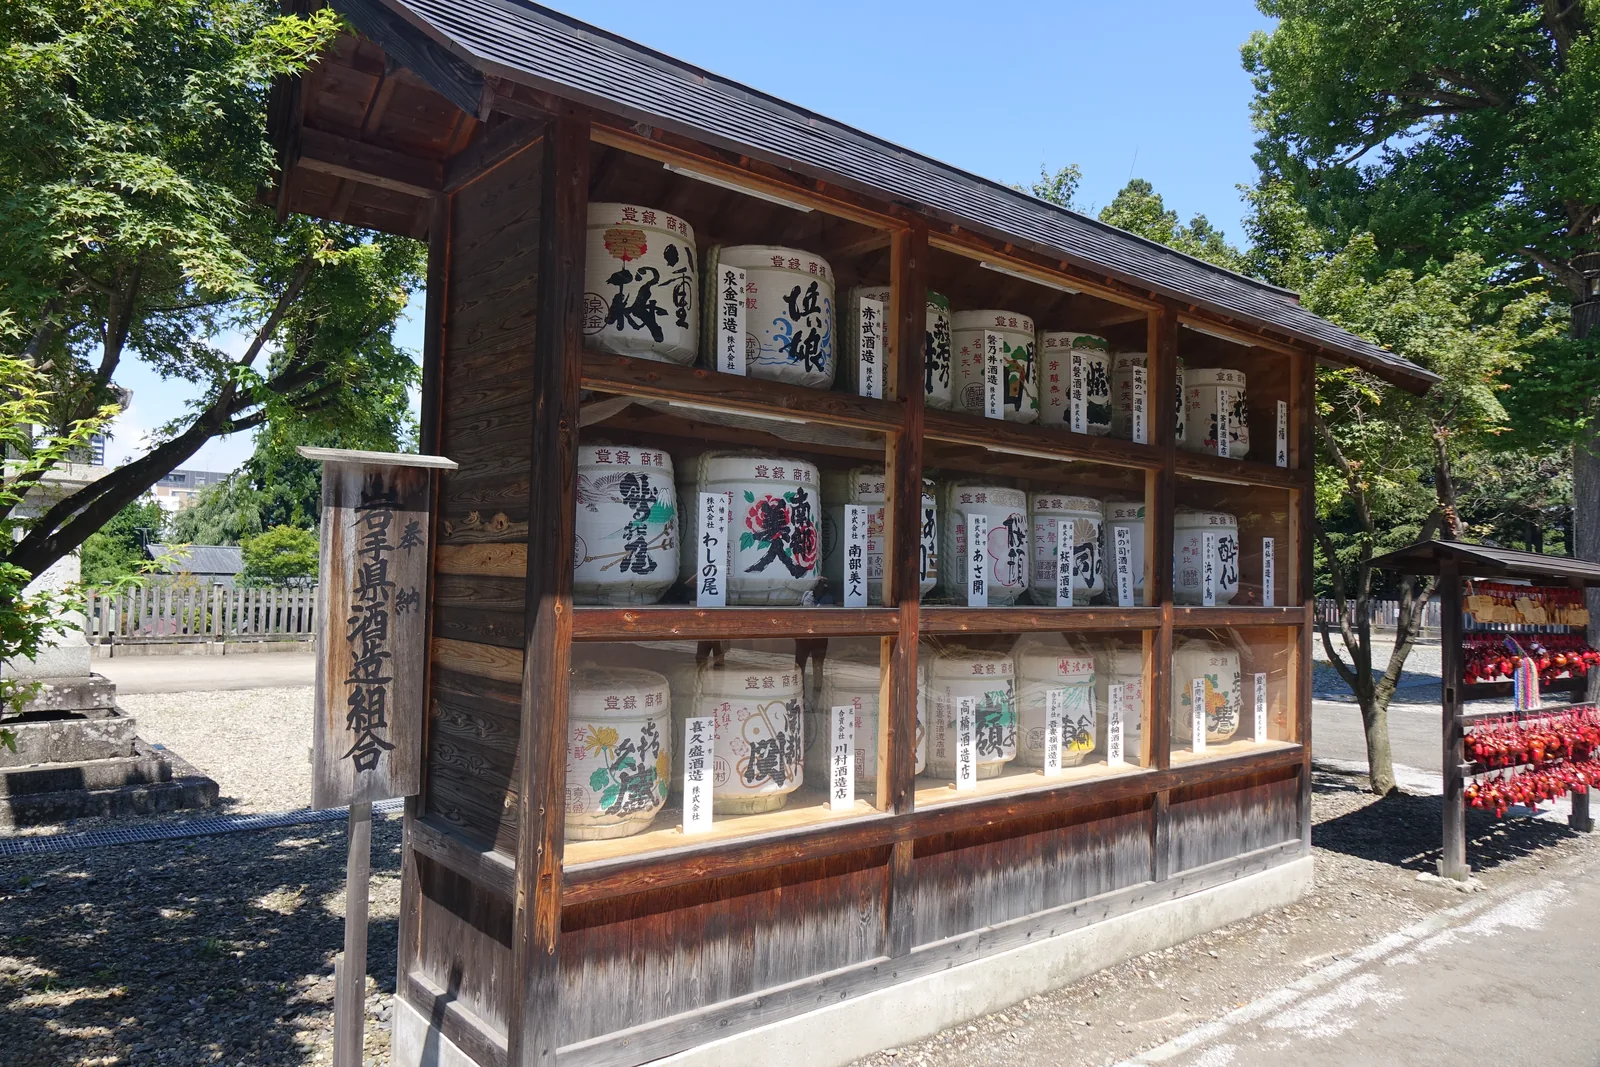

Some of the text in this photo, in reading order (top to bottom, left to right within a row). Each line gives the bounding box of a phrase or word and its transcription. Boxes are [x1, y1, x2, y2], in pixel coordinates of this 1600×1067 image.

[622, 206, 688, 237] 登録商標
[770, 255, 826, 278] 登録商標
[722, 270, 738, 370] 泉金酒造 株式会社
[861, 306, 876, 364] 赤武酒造
[595, 449, 664, 467] 登録商標
[755, 465, 811, 482] 登録商標
[396, 517, 424, 615] 奉納
[701, 496, 718, 596] 株式会社 わしの尾
[1117, 529, 1128, 575] 菊の司酒造
[848, 544, 862, 597] 南部美人
[972, 549, 984, 596] あさ開
[1059, 551, 1070, 599] 桜顔酒造
[340, 482, 399, 774] 岩手県酒造組合
[604, 692, 663, 711] 登録商標
[745, 675, 799, 690] 登録商標
[834, 709, 848, 800] 合資会社 川村酒造店
[960, 700, 970, 780] 高橋酒造店
[1111, 712, 1120, 758] 月の輪酒造店
[688, 721, 705, 821] 喜久盛酒造 株式会社
